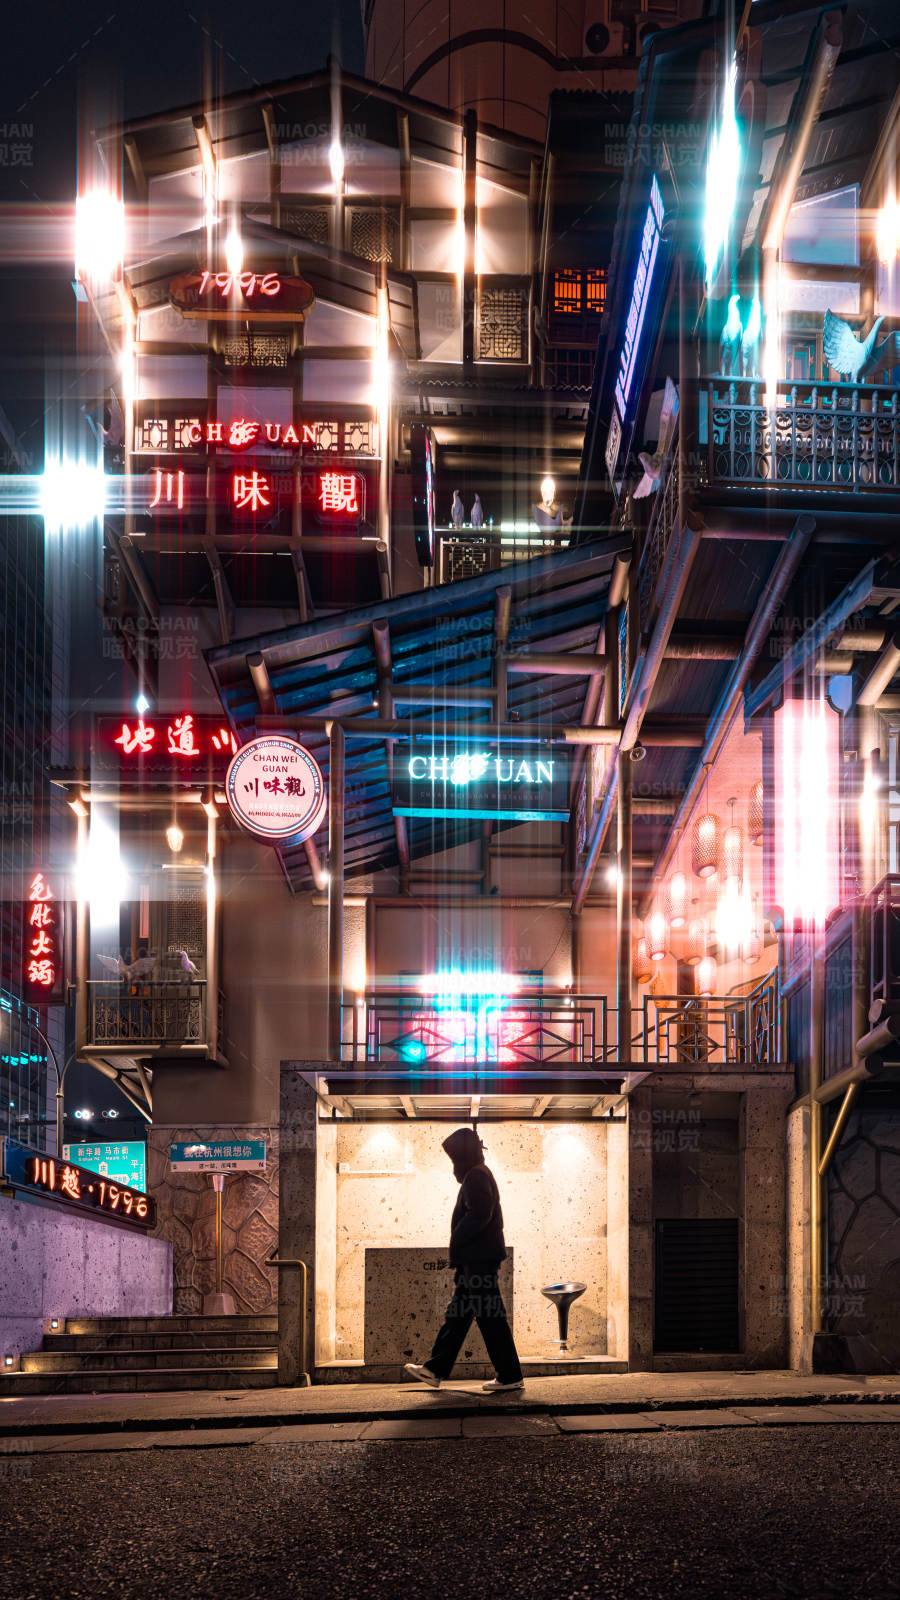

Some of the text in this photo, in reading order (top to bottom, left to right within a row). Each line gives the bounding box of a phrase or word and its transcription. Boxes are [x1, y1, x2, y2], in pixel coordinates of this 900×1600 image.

[199, 271, 280, 296] 1996
[149, 470, 358, 512] 川味觀
[253, 754, 298, 763] CHAN WEI
[262, 765, 288, 773] GUAN
[494, 759, 555, 784] UAN
[244, 776, 306, 798] 川味觀
[28, 873, 54, 985] 毛肚火锅
